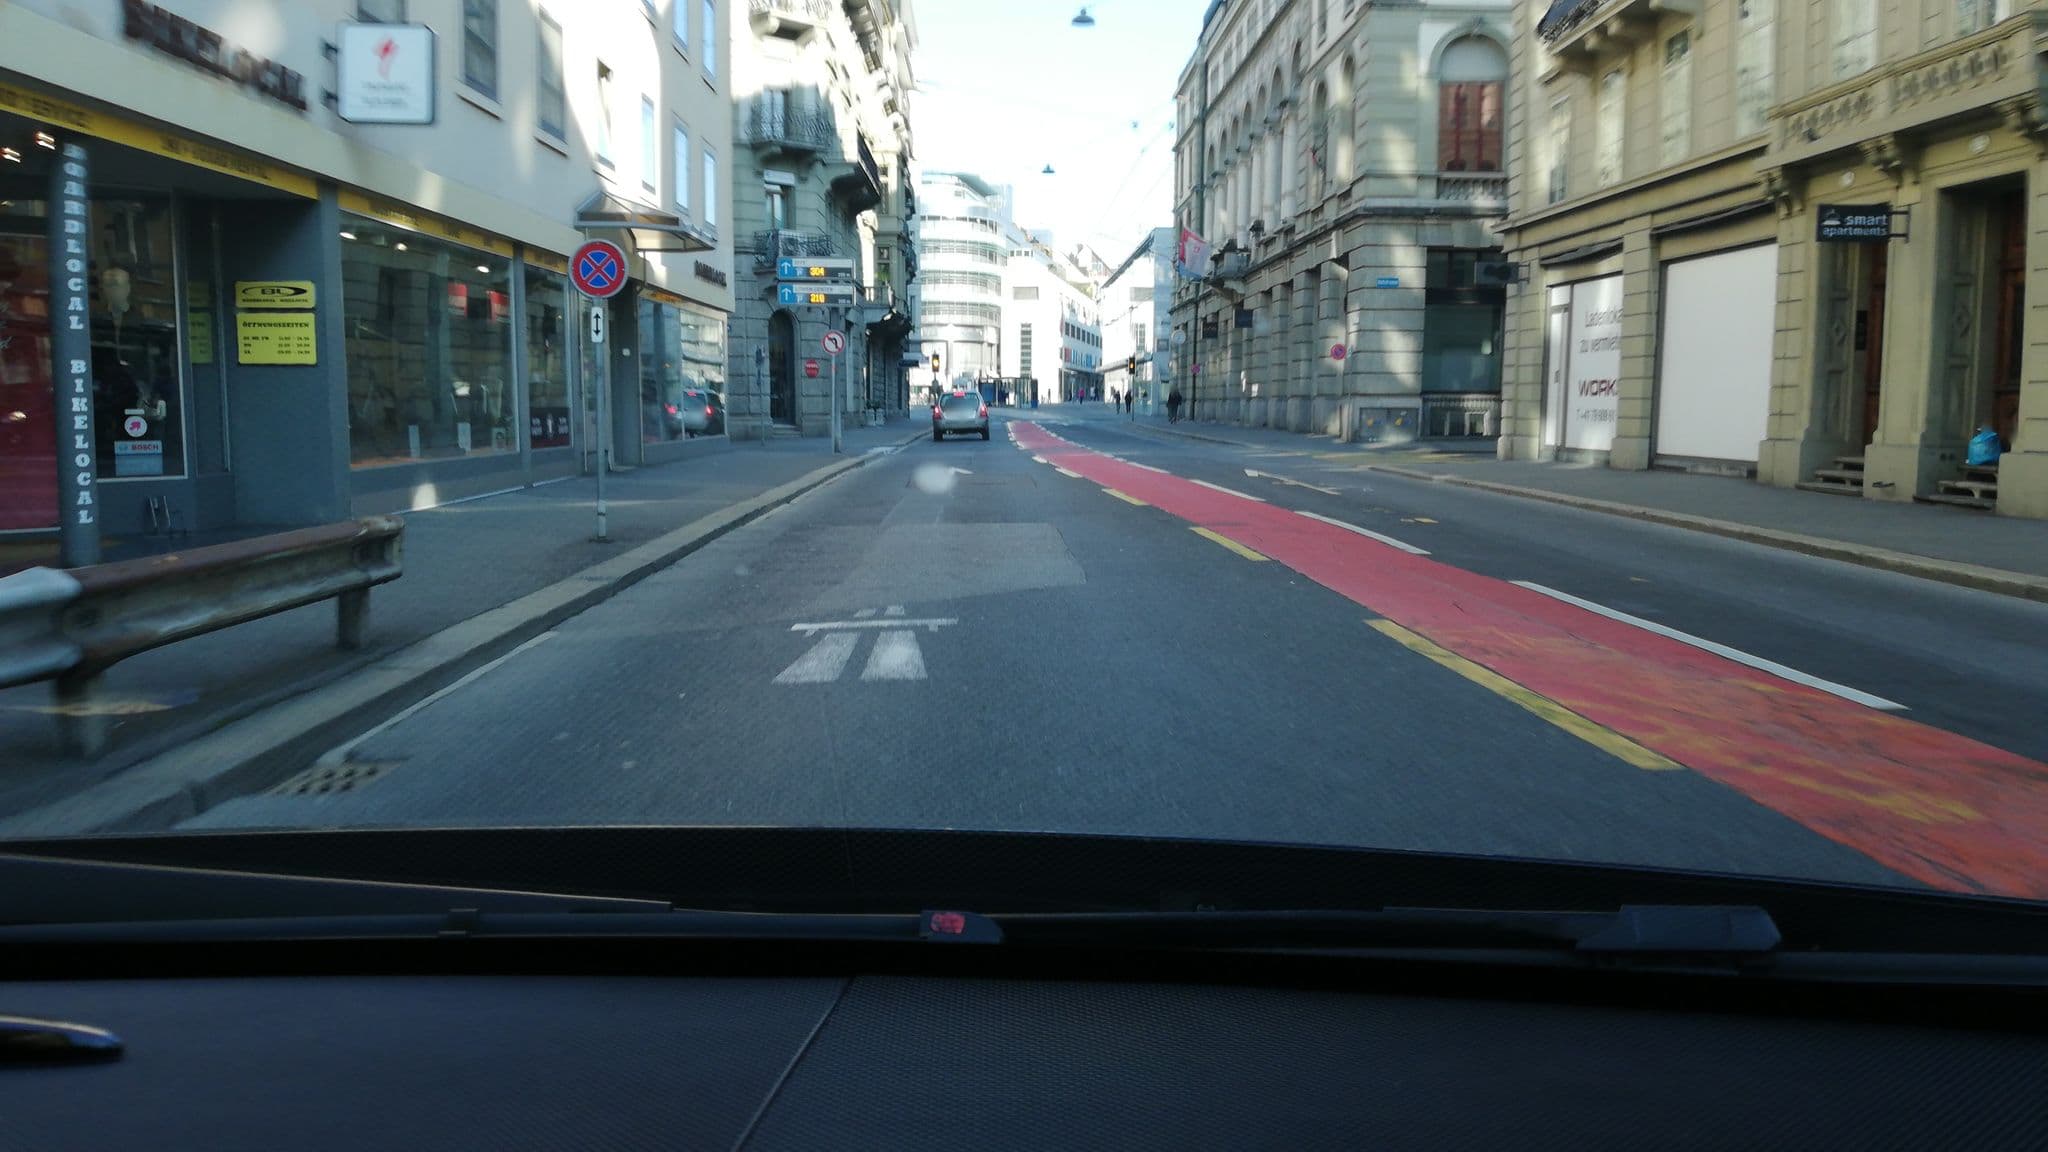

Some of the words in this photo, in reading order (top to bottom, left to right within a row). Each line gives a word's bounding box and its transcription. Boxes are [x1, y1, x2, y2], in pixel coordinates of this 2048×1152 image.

[1845, 213, 1888, 225] smart
[1823, 226, 1888, 237] apartments
[71, 359, 93, 524] BIKELOCAL
[131, 443, 159, 451] BOSCH
